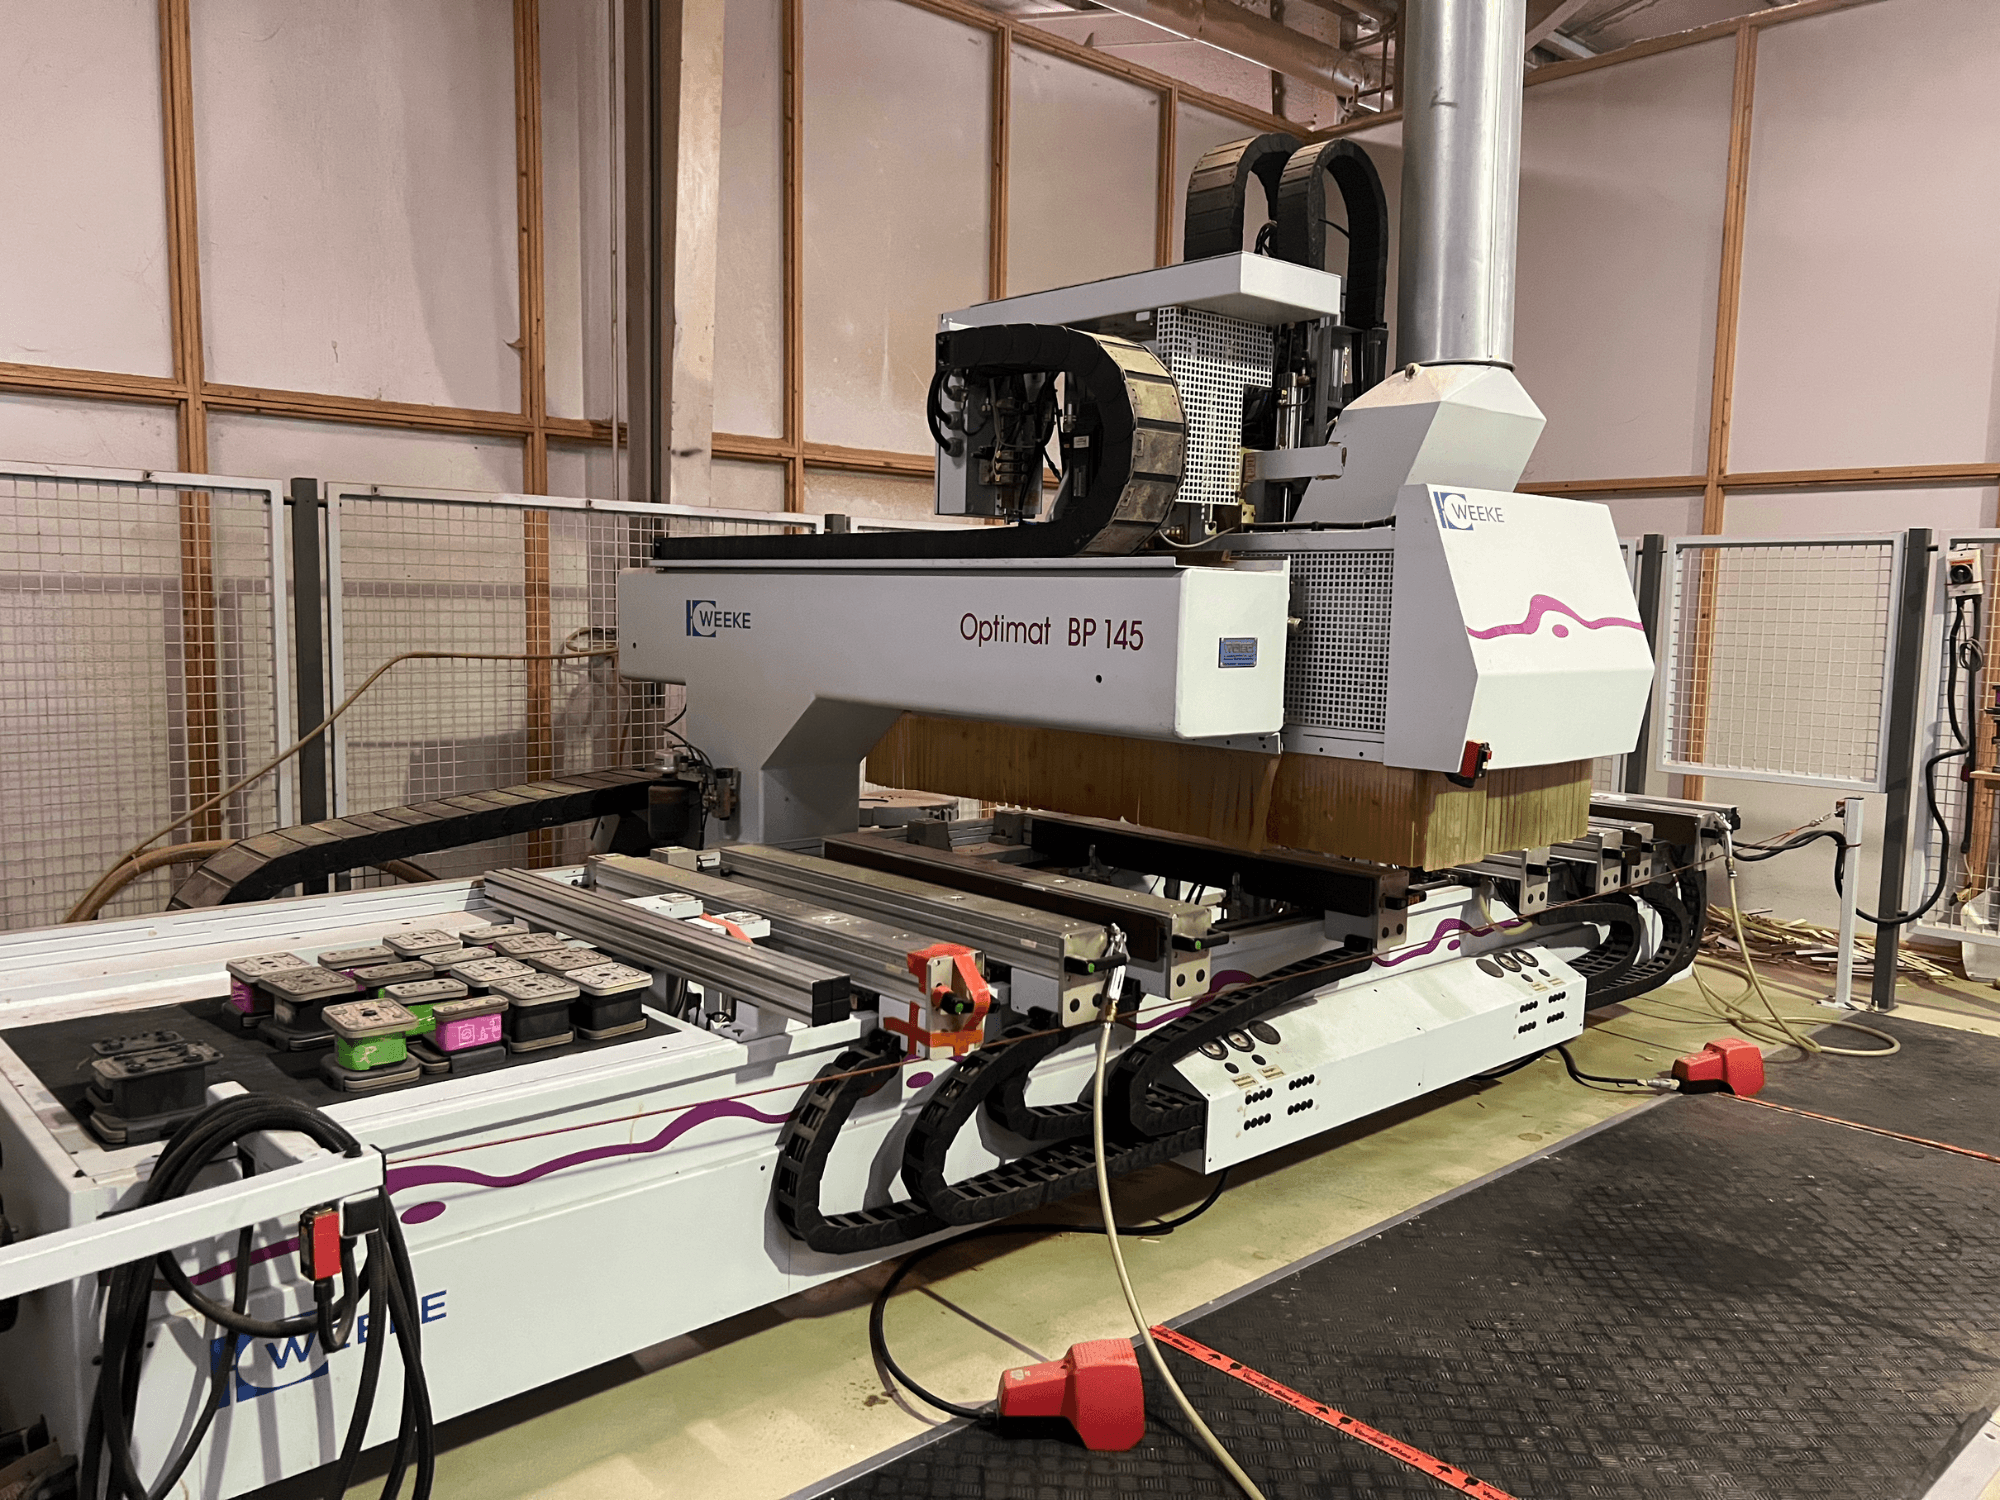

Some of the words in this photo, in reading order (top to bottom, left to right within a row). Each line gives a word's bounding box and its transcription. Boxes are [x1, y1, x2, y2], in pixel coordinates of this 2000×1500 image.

[1451, 503, 1504, 522] WEEKE
[699, 610, 751, 629] WEEKE
[960, 612, 1051, 648] Optimat
[1068, 617, 1097, 647] BP
[1104, 619, 1144, 651] 145
